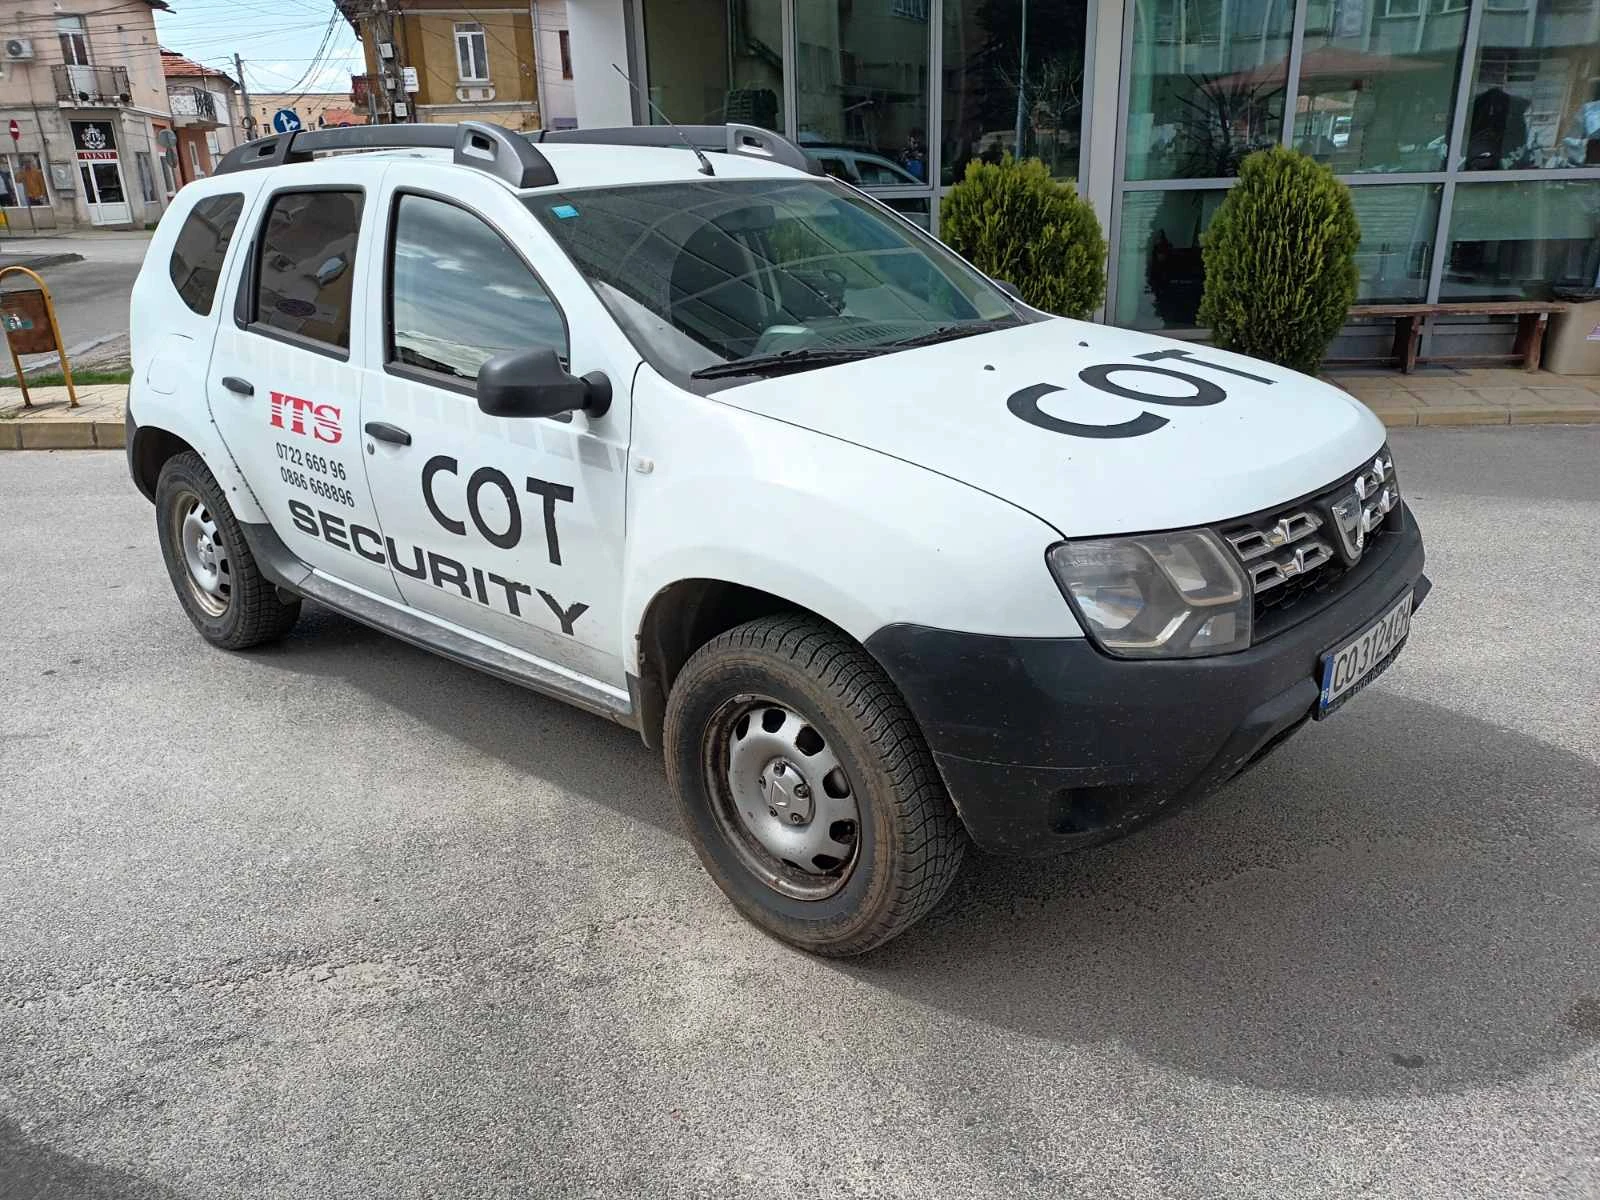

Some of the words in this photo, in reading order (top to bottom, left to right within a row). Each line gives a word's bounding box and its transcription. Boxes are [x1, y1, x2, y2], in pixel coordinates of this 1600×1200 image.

[270, 391, 342, 443] ITS
[1007, 349, 1278, 439] COT
[276, 442, 303, 466] 0722
[305, 452, 327, 474] 669
[330, 460, 346, 480] 96
[280, 466, 308, 490] 0886
[309, 477, 355, 507] 668896
[422, 455, 574, 566] COT
[288, 499, 590, 636] SECURITY
